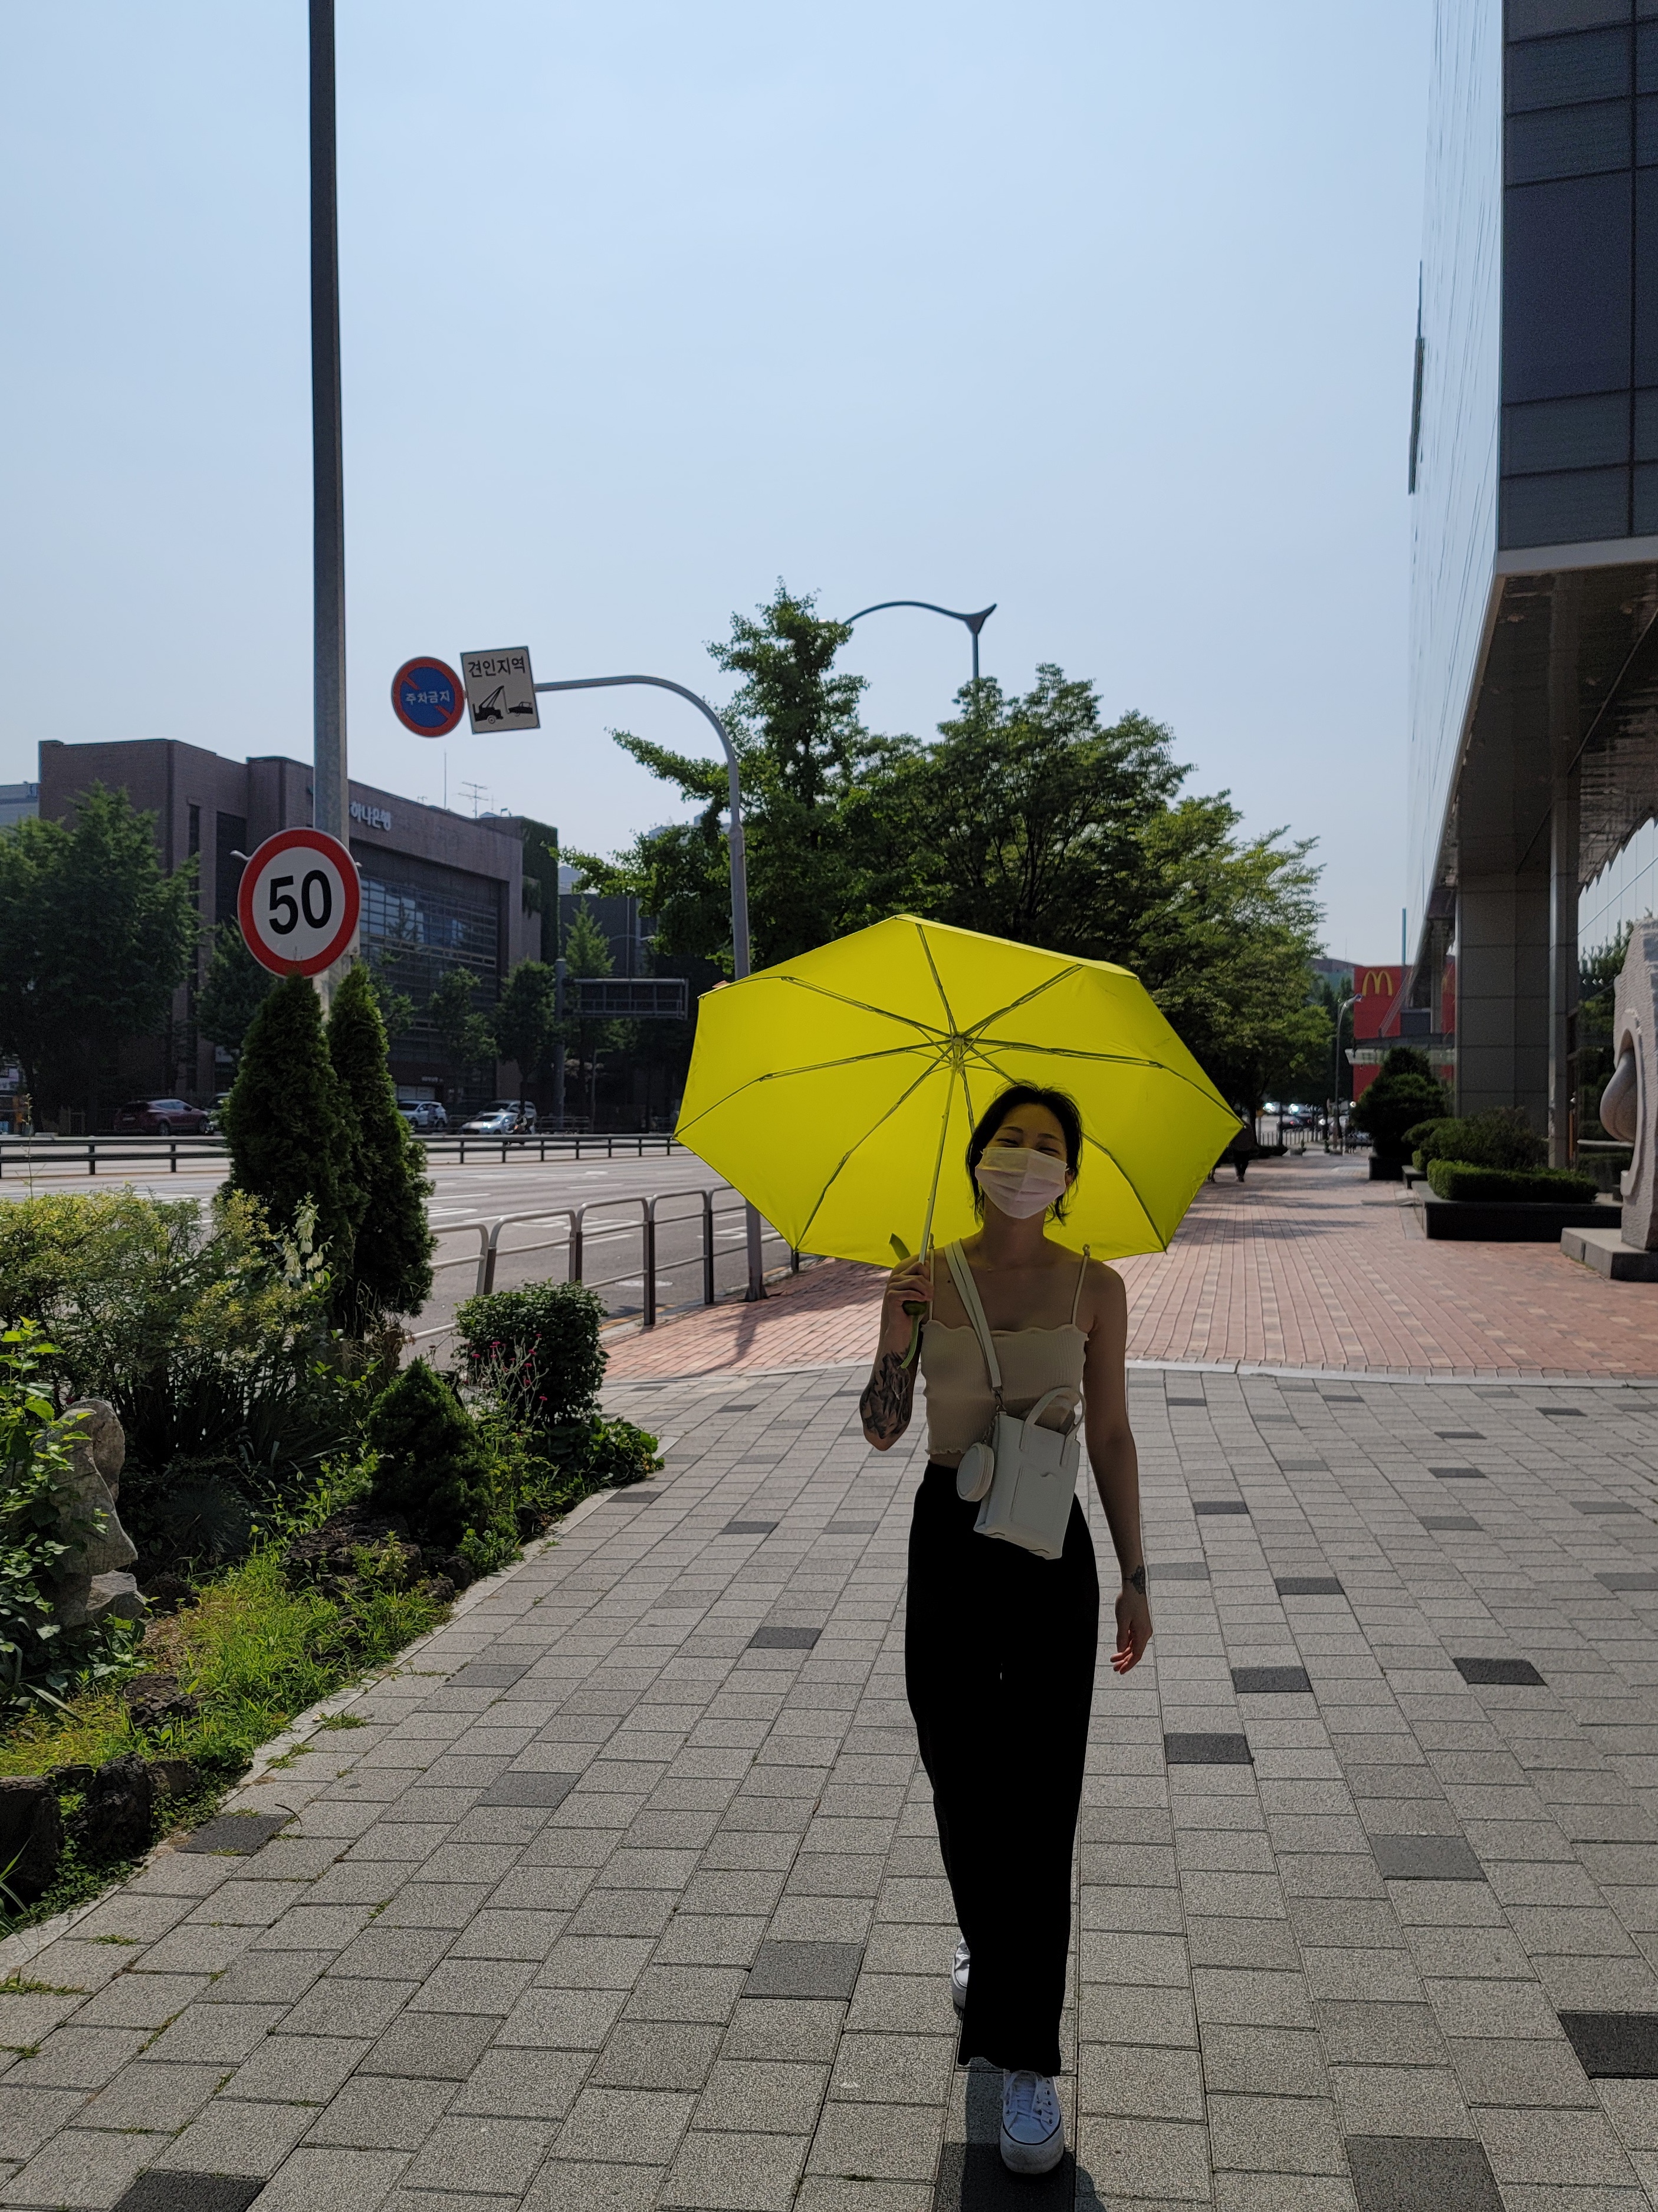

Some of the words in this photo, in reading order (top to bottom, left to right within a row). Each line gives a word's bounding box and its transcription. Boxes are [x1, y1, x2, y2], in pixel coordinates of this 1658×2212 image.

[468, 656, 526, 678] 견인지역
[406, 690, 450, 705] 주차금지
[350, 800, 391, 831] 하나은행
[268, 870, 332, 935] 50
